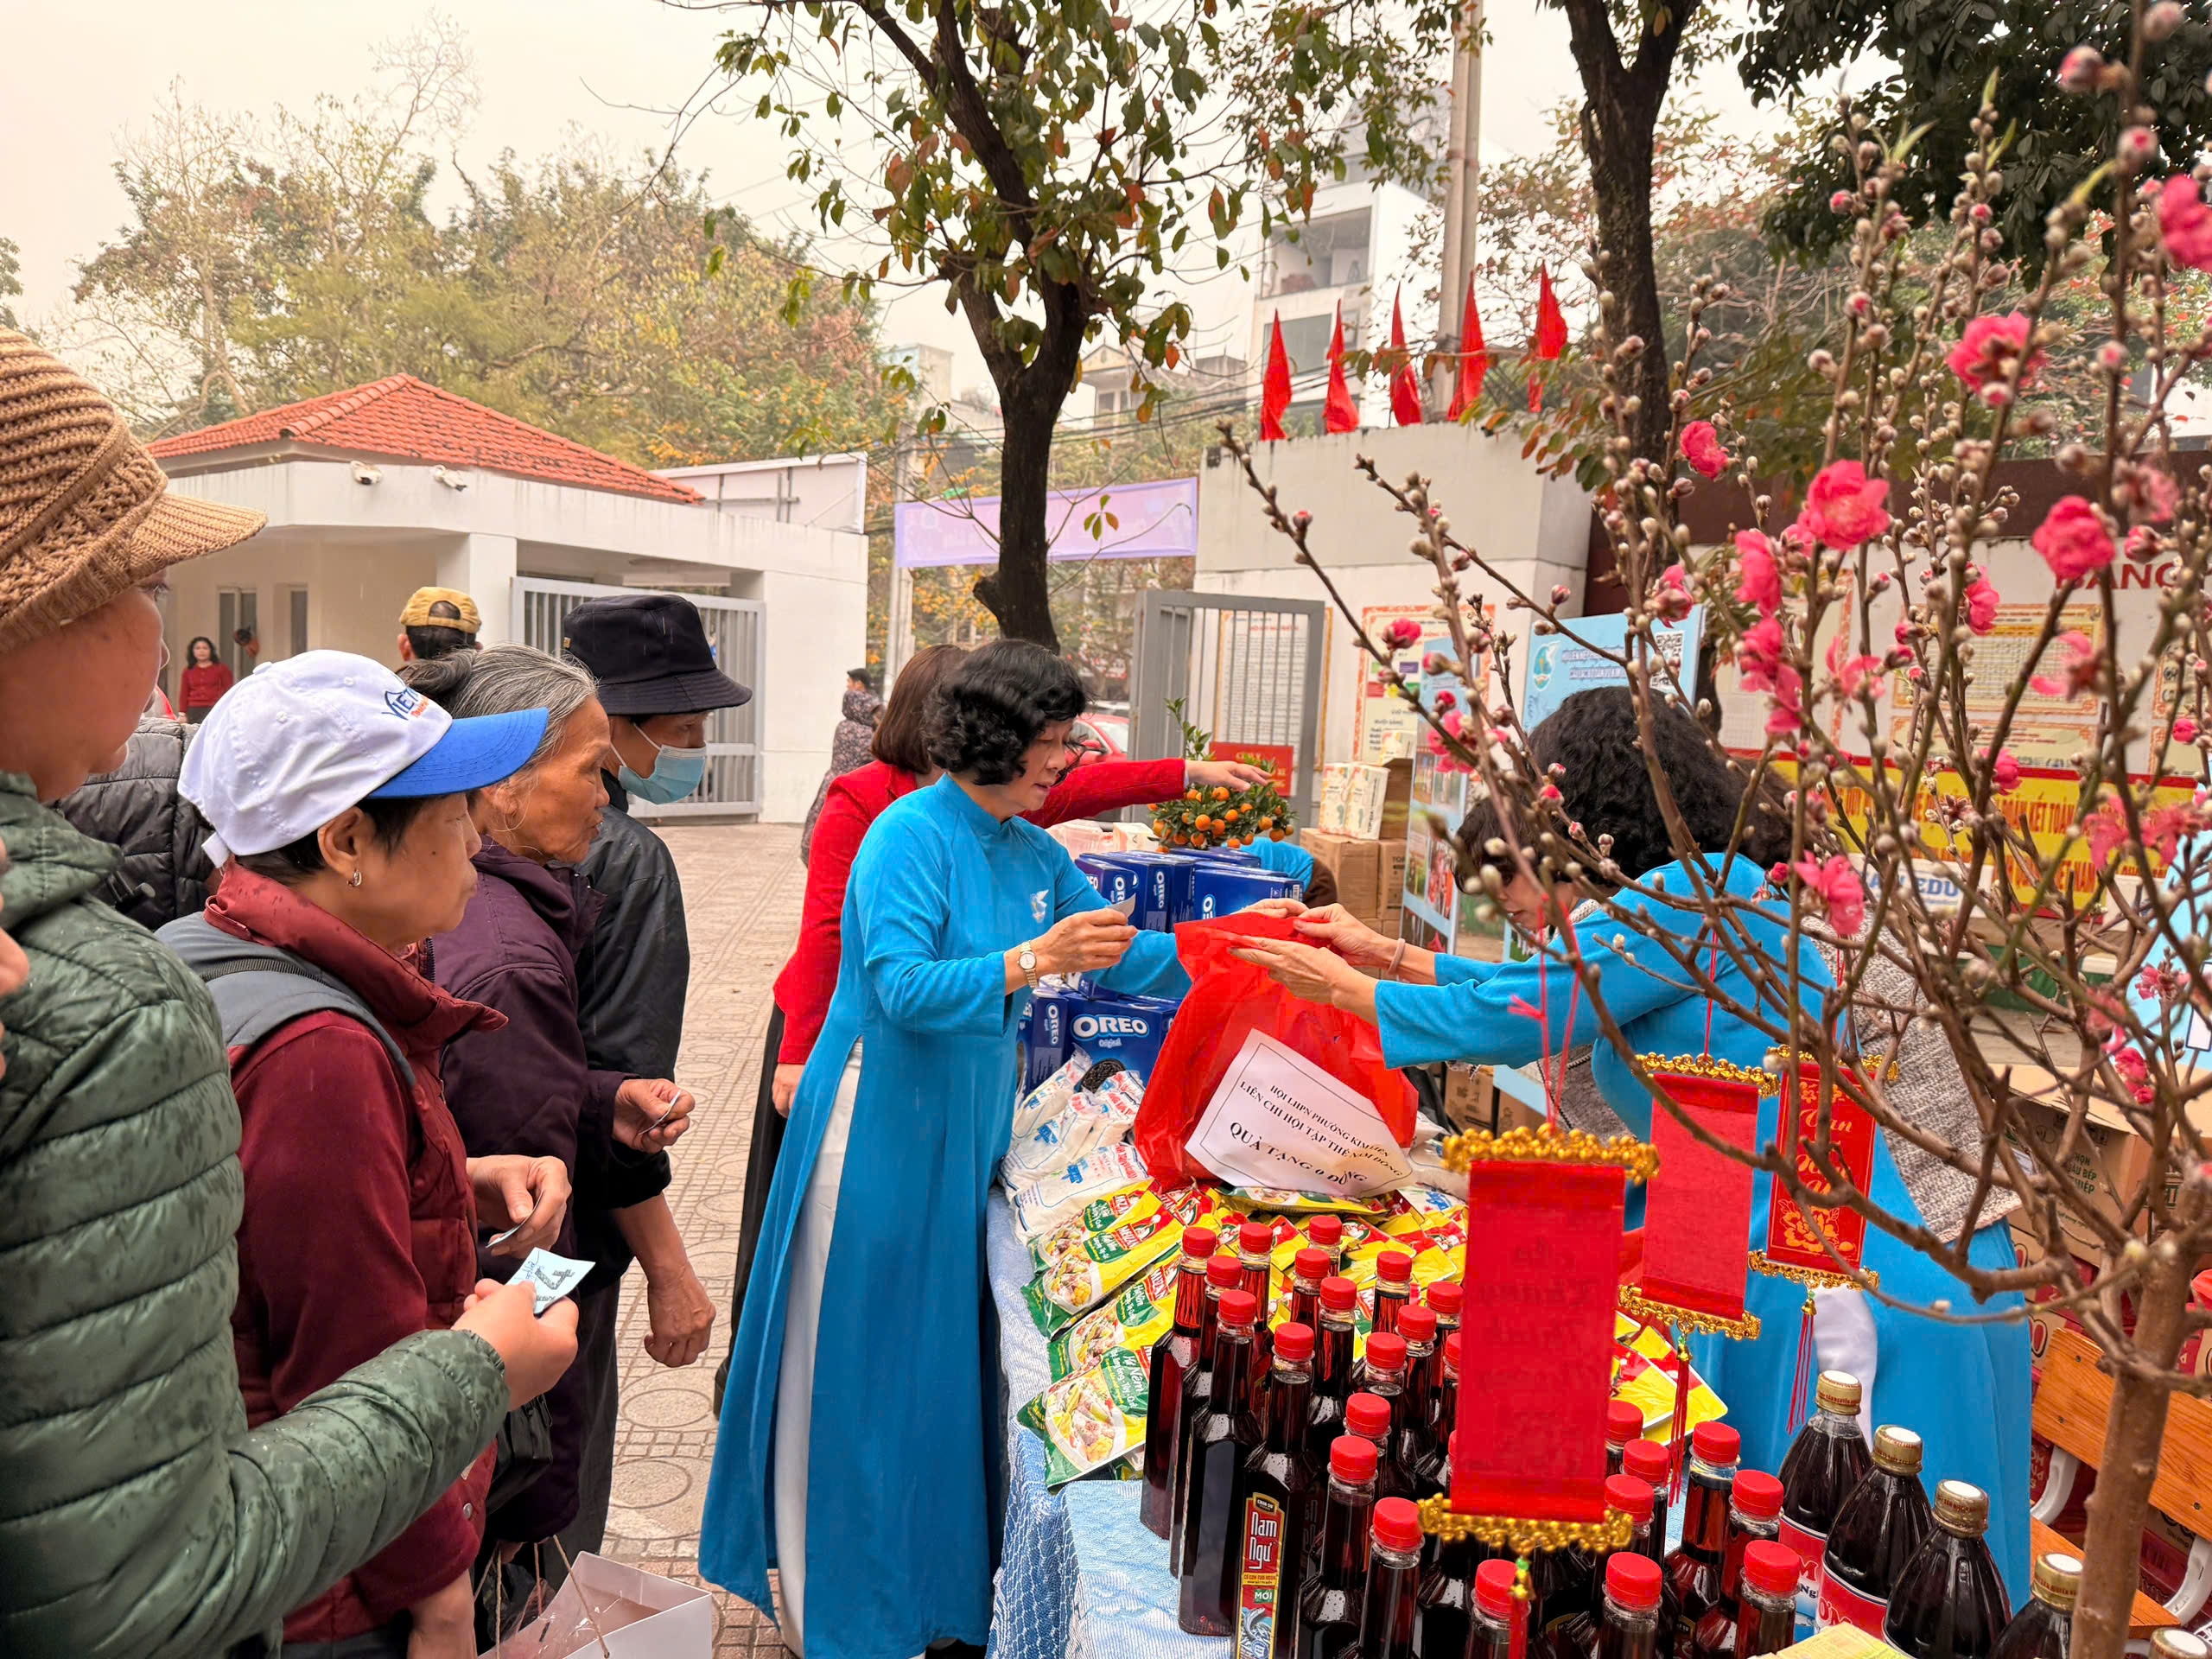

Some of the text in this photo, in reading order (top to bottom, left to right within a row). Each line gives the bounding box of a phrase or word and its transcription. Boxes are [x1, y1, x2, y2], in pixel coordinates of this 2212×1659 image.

[1156, 871, 1166, 909] OREO
[1048, 1005, 1059, 1045] OREO
[1073, 1016, 1148, 1038] OREO
[1240, 1081, 1264, 1103] LIÊN
[1263, 1099, 1283, 1116] CHI
[1283, 1113, 1305, 1131] HỘI
[1230, 1122, 1262, 1152] QUÀ
[1250, 1511, 1277, 1538] Nam
[1249, 1536, 1273, 1569] Ngư
[1254, 1589, 1273, 1600] MỚI
